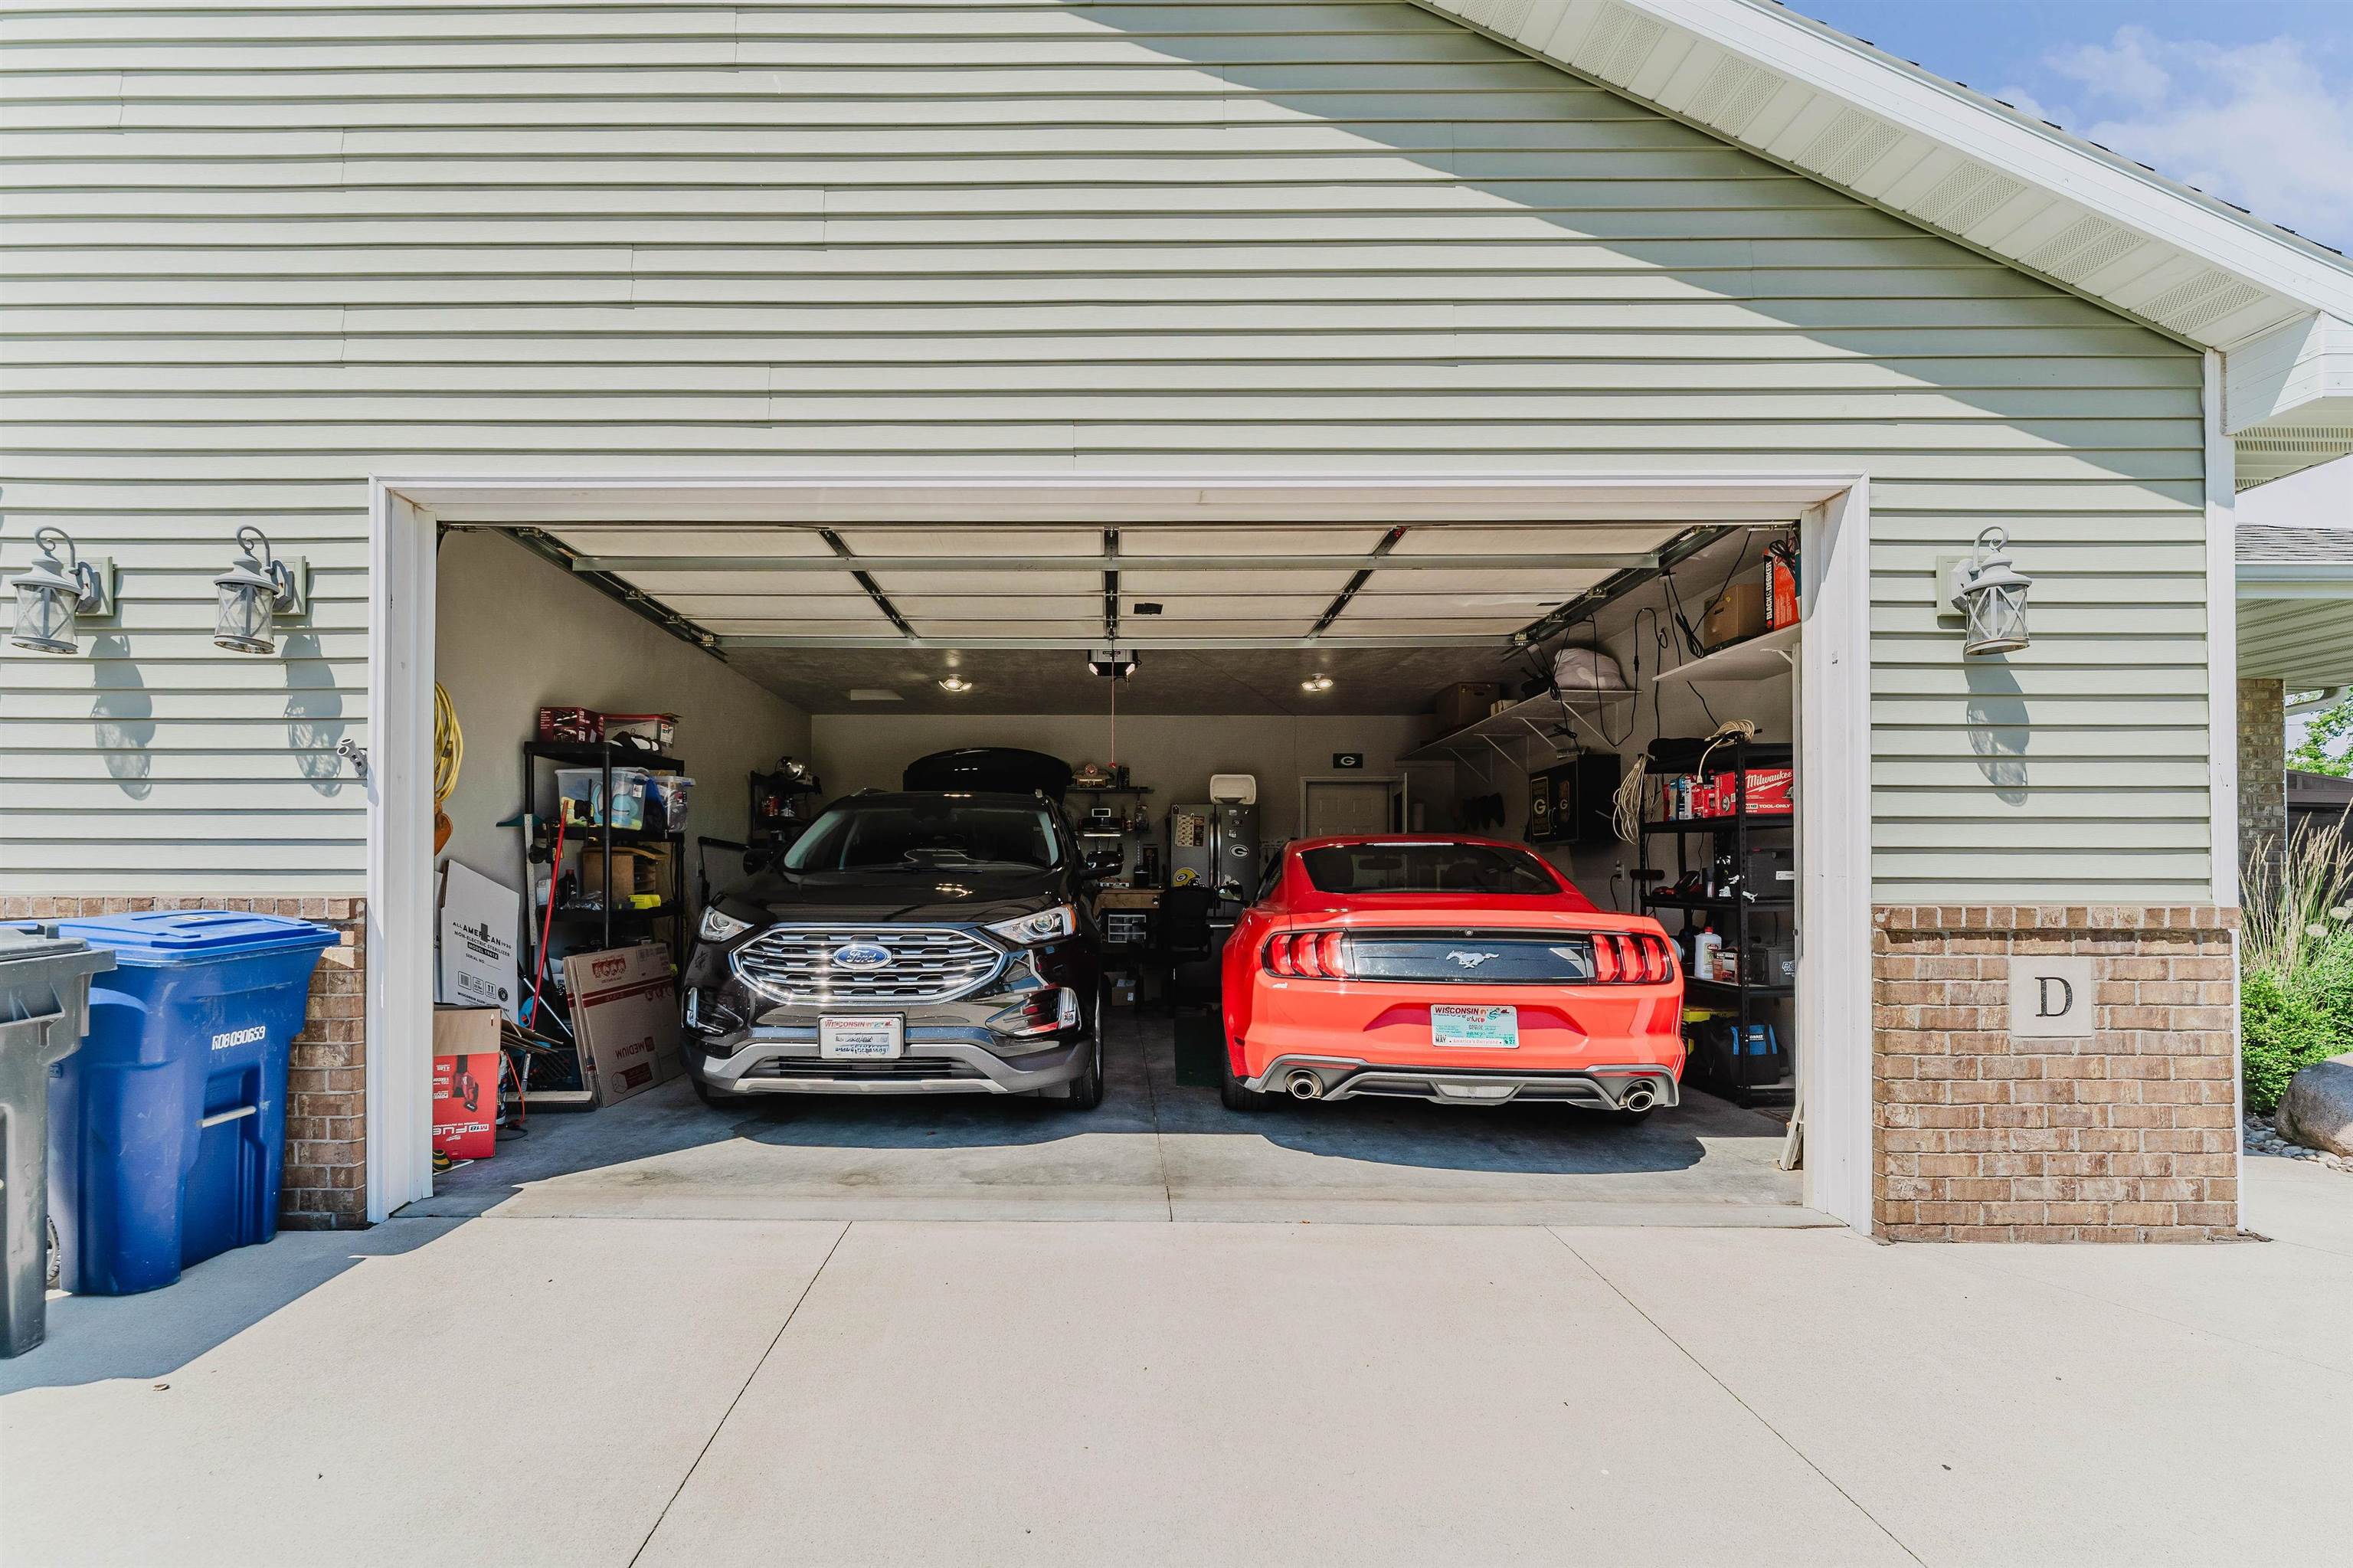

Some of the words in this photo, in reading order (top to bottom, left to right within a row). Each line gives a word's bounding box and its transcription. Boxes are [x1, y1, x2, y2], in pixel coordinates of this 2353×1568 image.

[1745, 771, 1792, 788] Milwaukee
[454, 931, 487, 948] NON-ELECTRIC
[487, 944, 510, 957] STERILIZER
[466, 953, 478, 962] SERIAL
[846, 950, 876, 962] Ford
[2035, 977, 2073, 1017] D
[615, 1041, 645, 1059] MEDIUM
[433, 1126, 466, 1135] FUE
